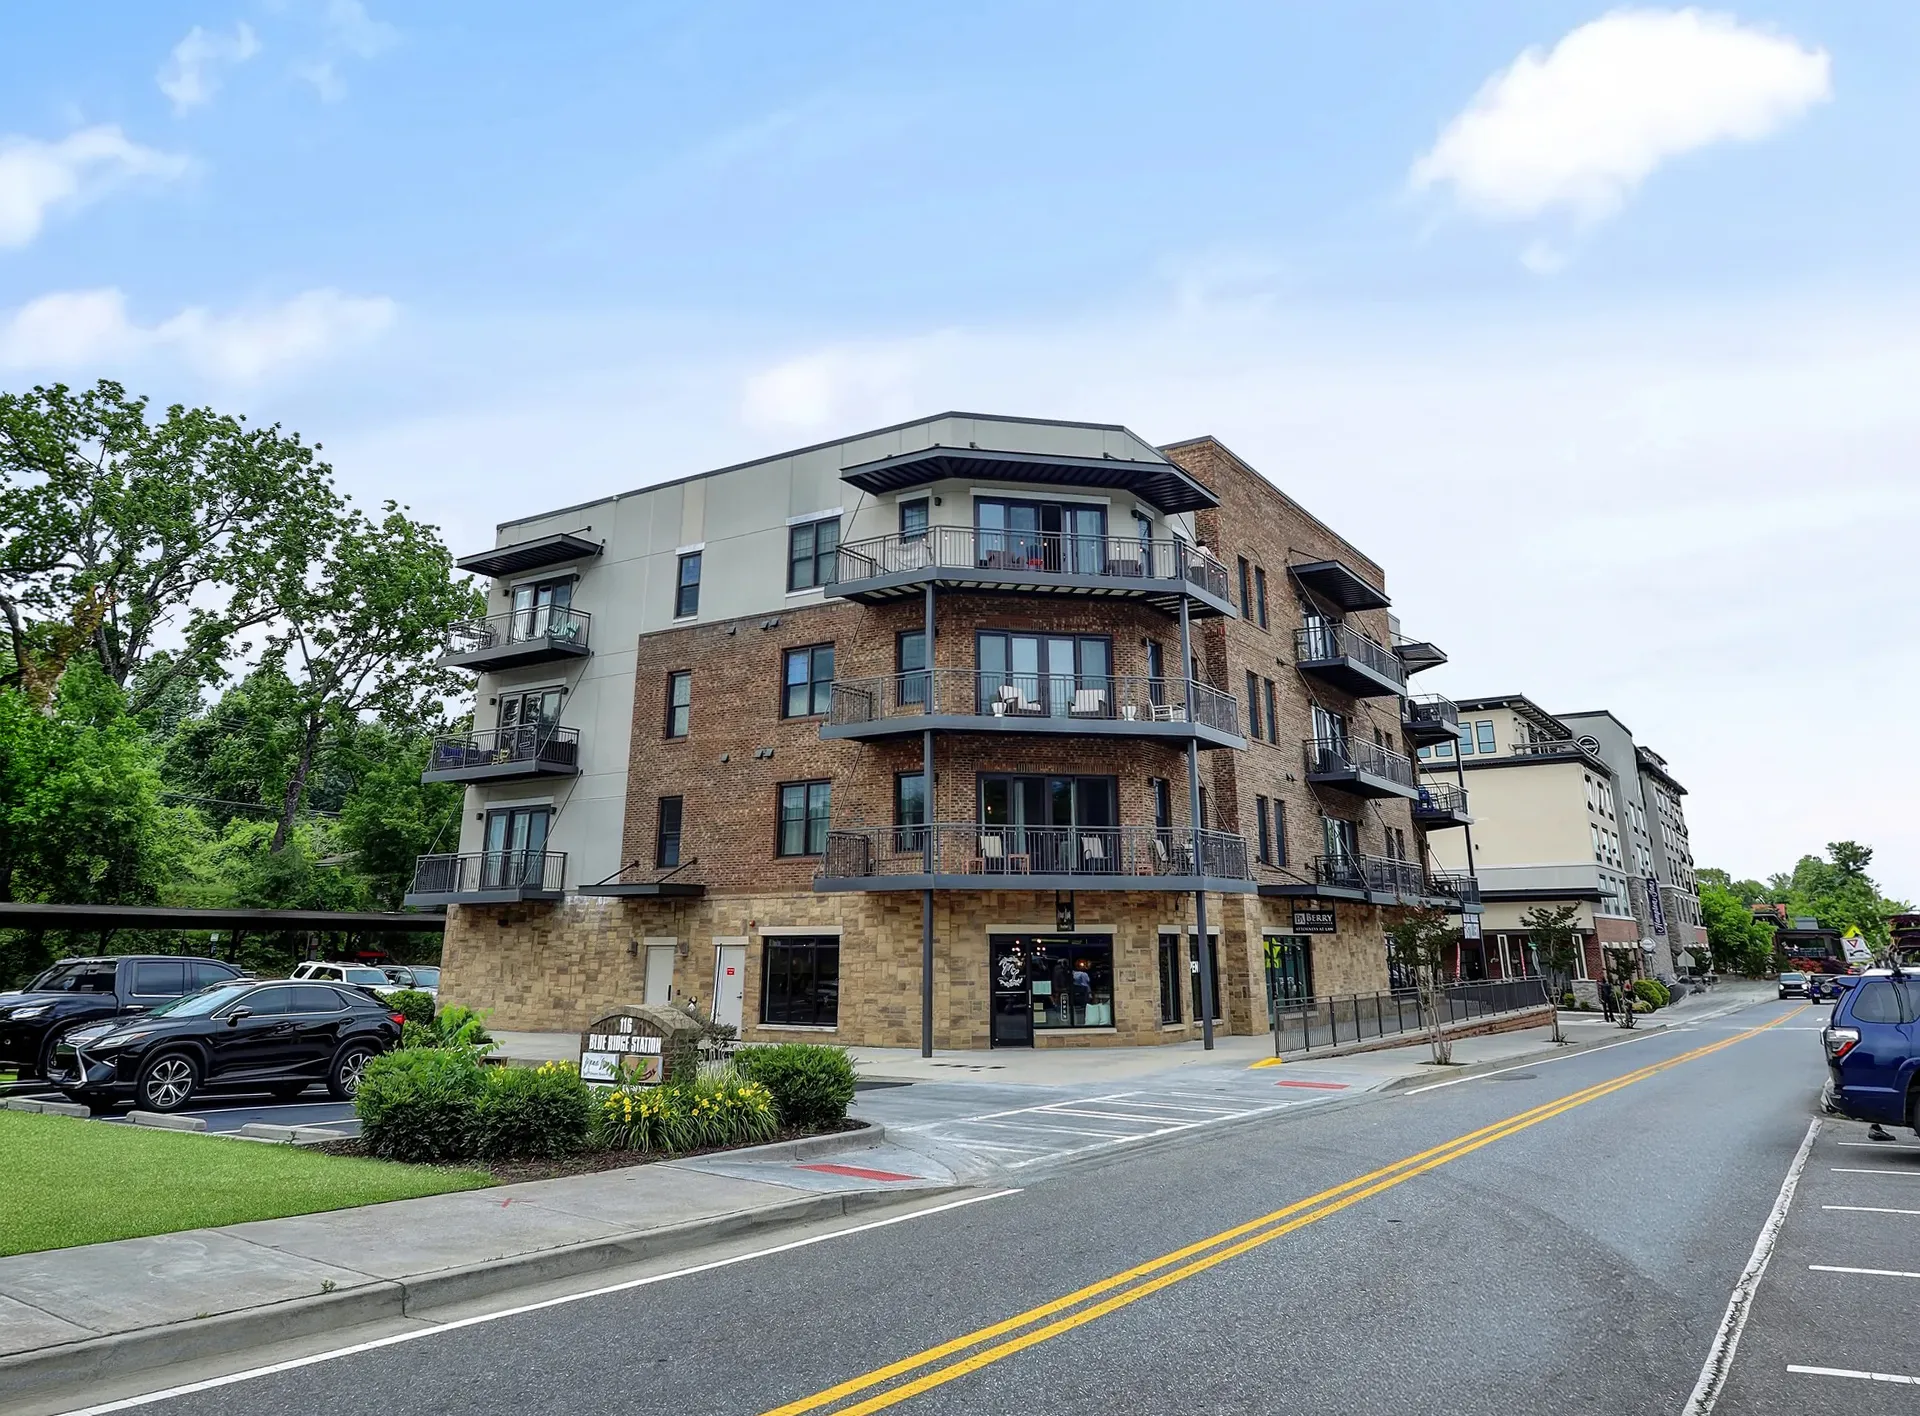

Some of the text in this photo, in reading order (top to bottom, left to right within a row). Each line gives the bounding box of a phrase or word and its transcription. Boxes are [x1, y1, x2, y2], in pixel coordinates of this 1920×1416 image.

[1305, 912, 1333, 922] BERRY
[619, 1017, 633, 1033] 116
[588, 1034, 662, 1054] BLUE RIDGE STATION
